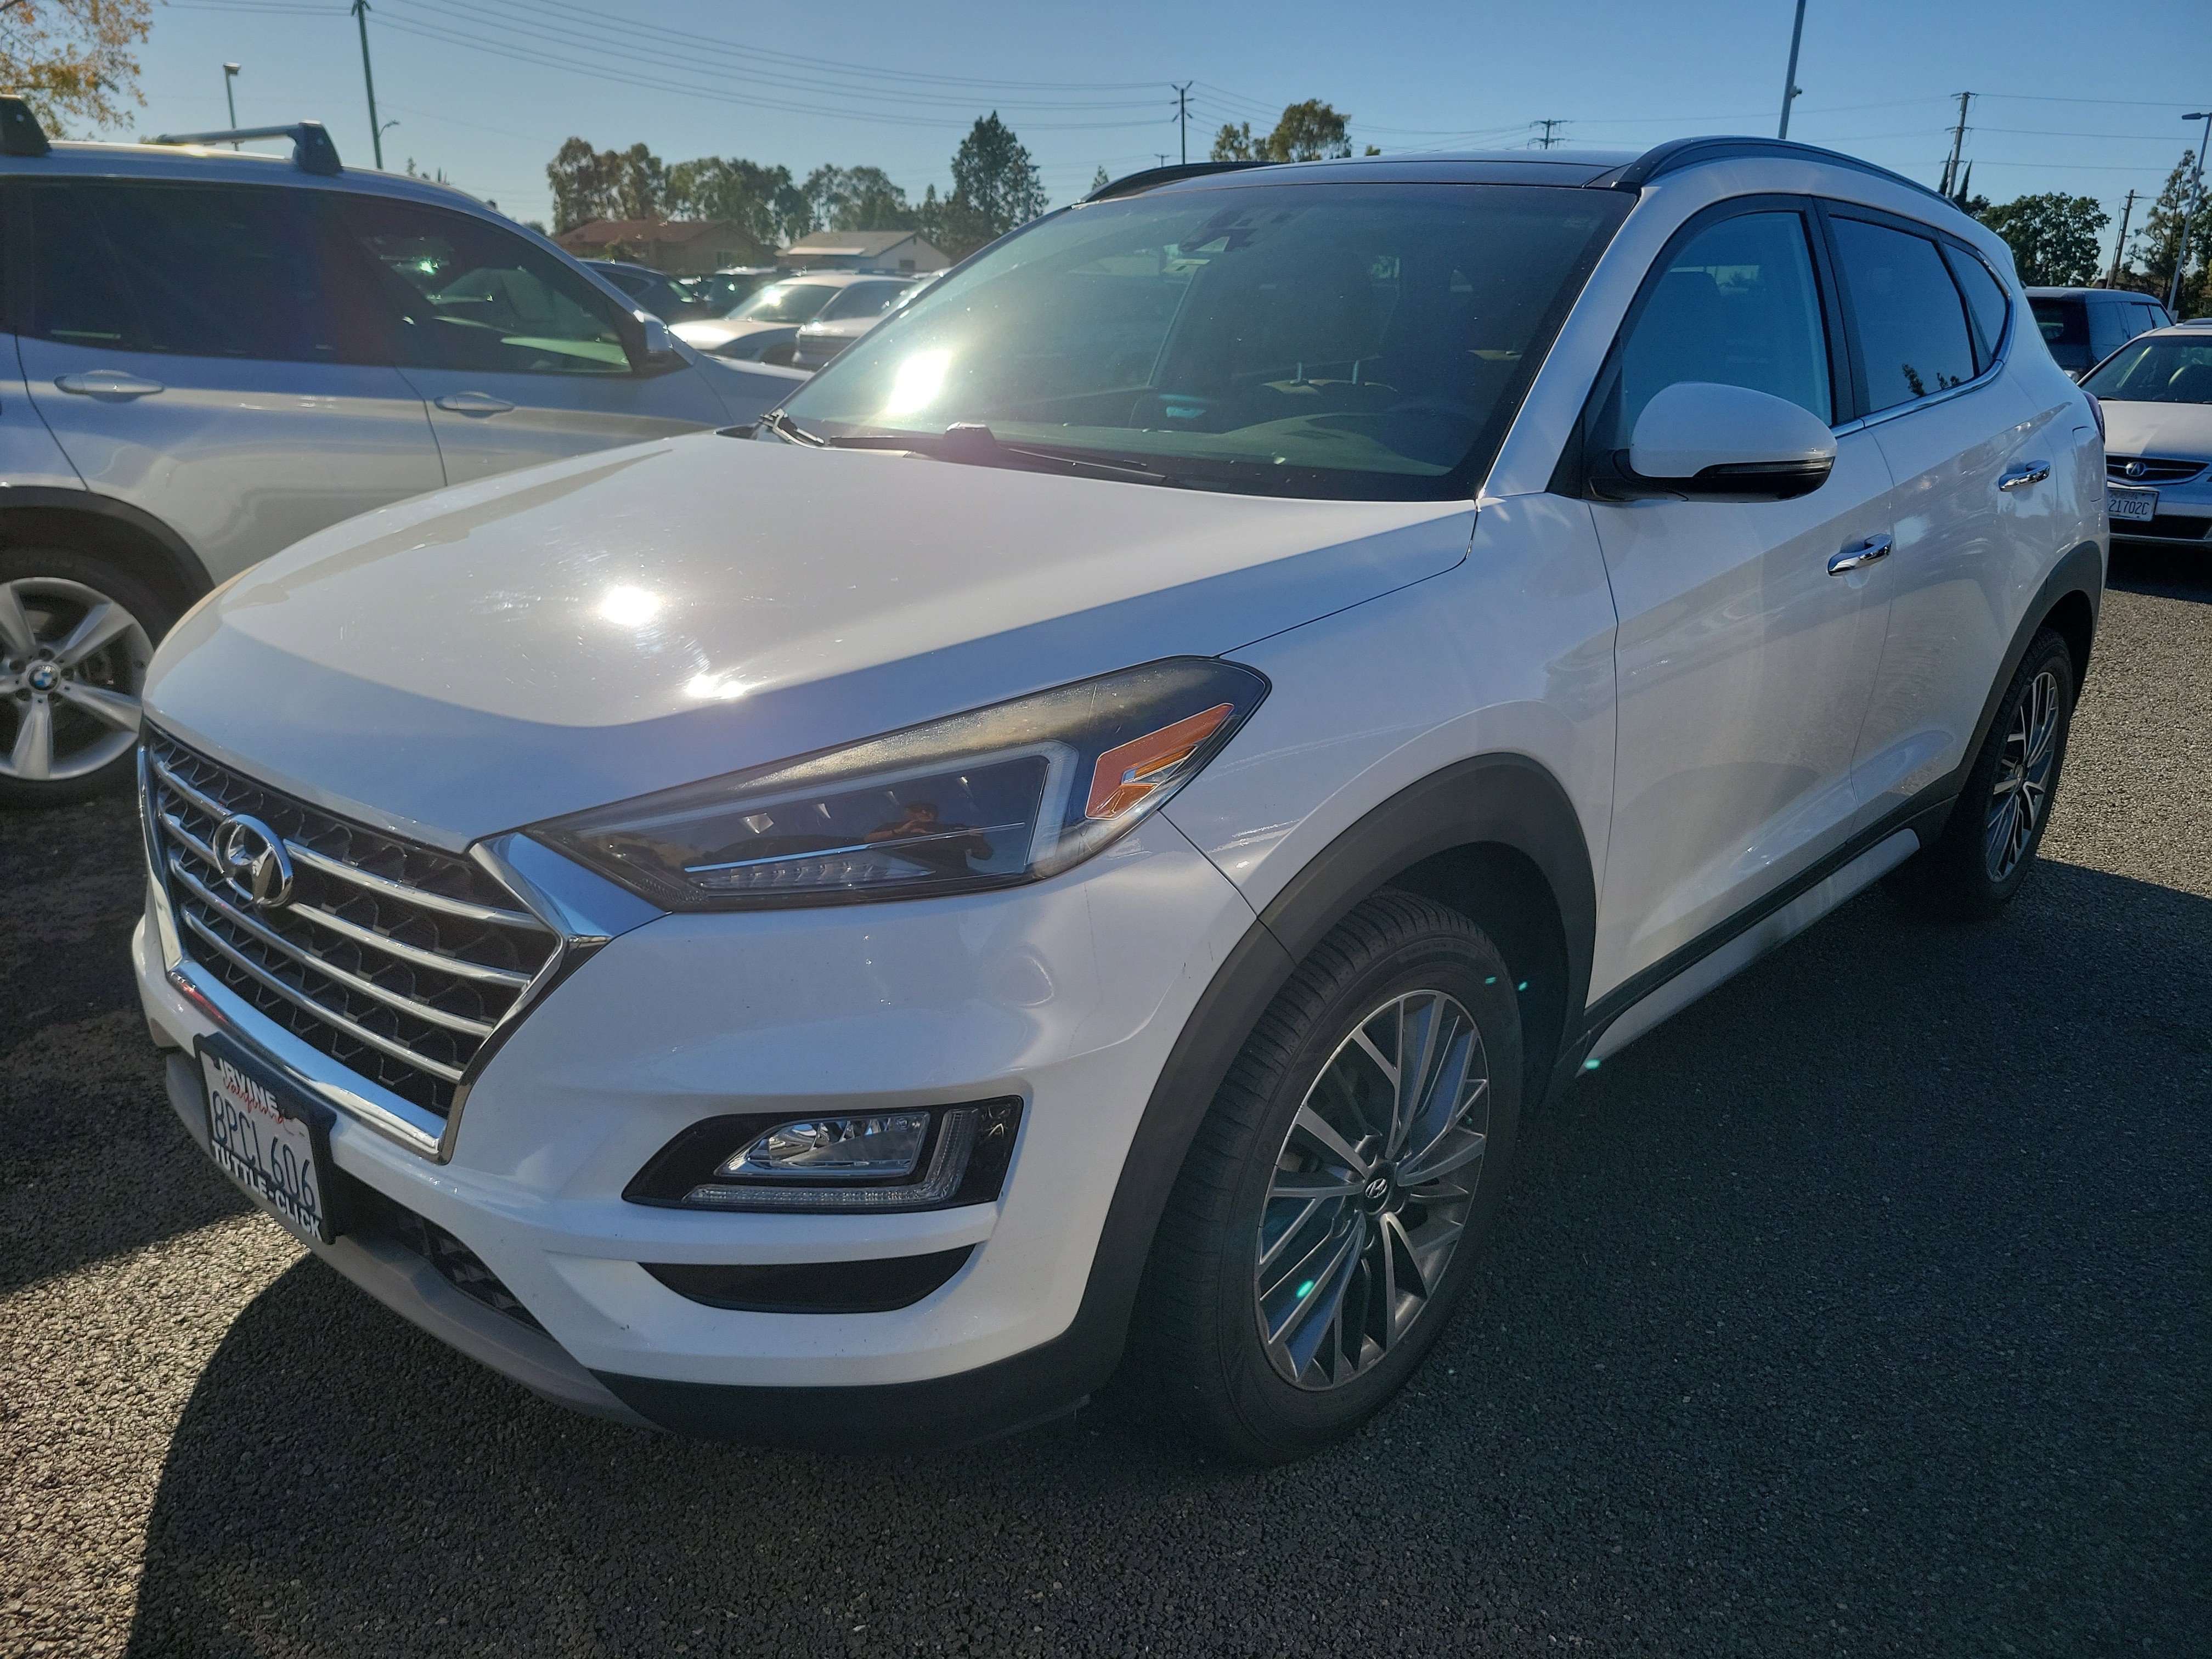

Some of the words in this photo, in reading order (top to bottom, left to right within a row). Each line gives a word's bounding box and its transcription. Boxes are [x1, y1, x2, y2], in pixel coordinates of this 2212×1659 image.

[2109, 499, 2149, 515] 21702C
[219, 1057, 280, 1116] IRVINE
[212, 1090, 316, 1214] 8PCL606
[212, 1139, 323, 1242] TUTTLE-CLICK
